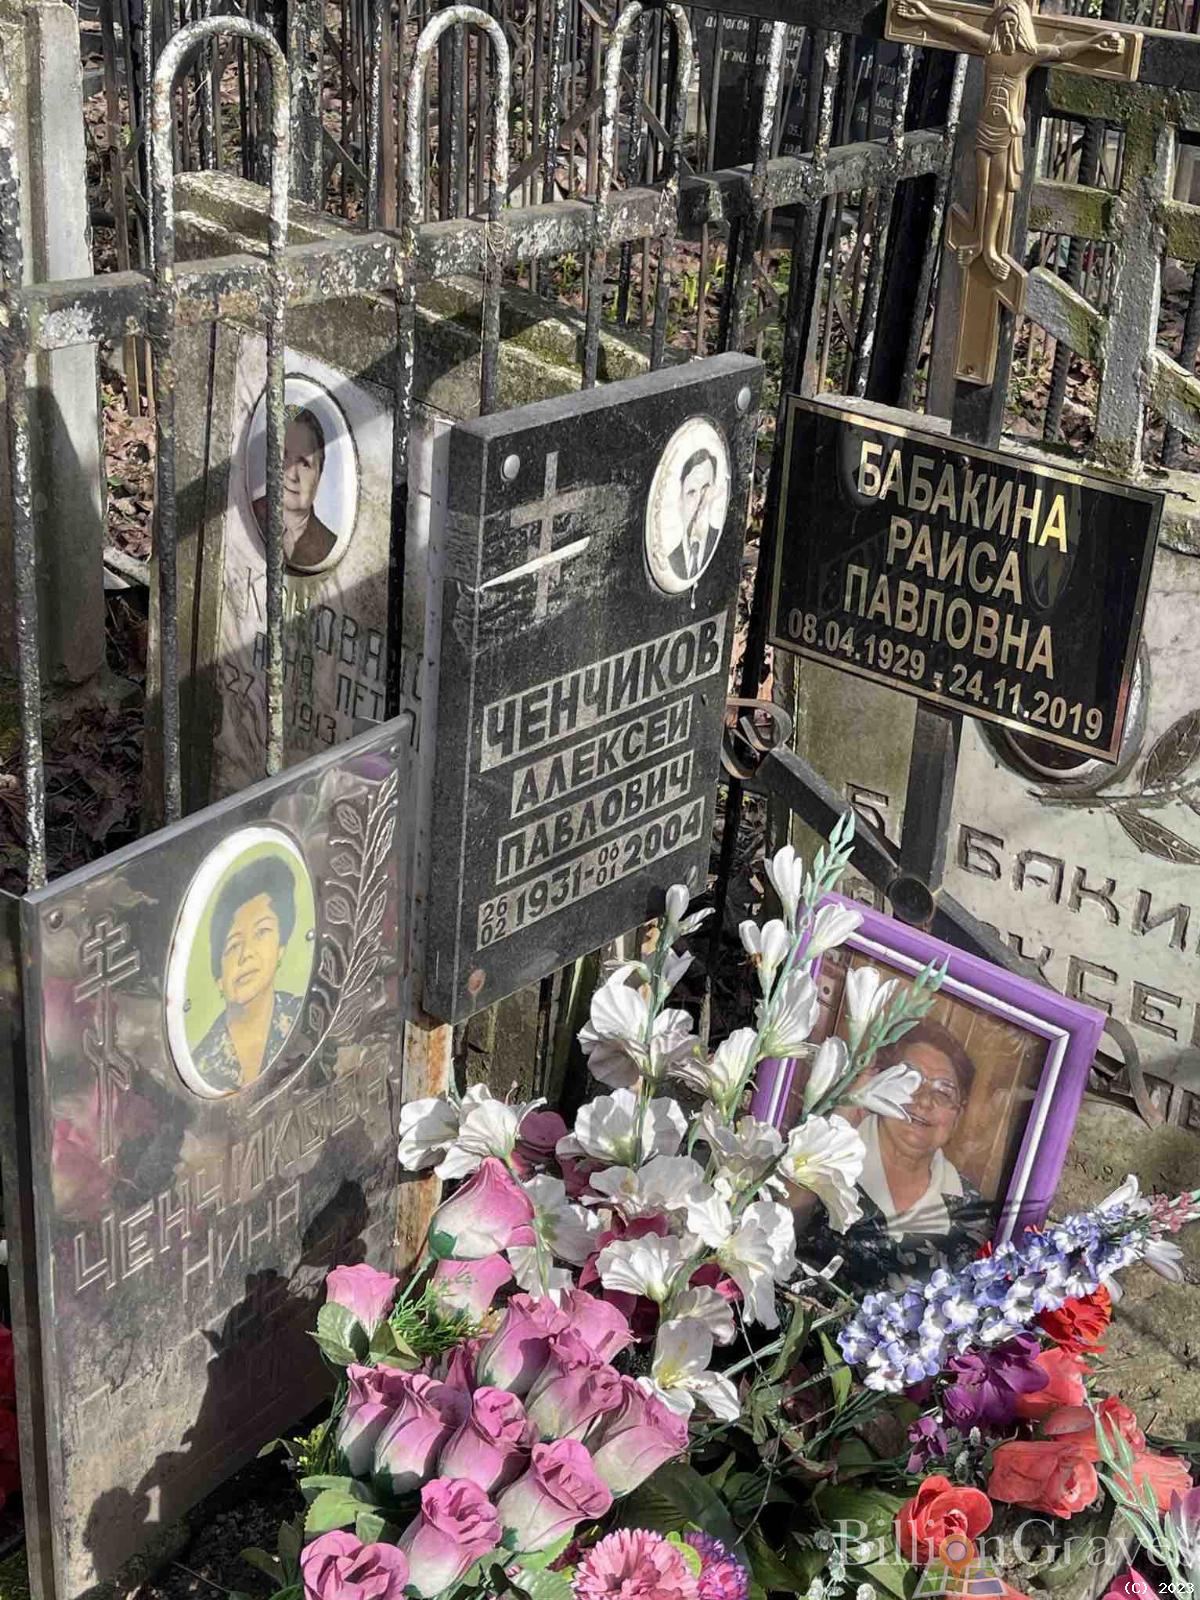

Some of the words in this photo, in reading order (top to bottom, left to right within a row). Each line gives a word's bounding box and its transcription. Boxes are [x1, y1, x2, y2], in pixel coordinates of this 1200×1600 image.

[857, 440, 1069, 553] БАБАКИНА
[886, 515, 1023, 605] РАИСА
[787, 606, 926, 681] 08.04.1929
[949, 662, 1104, 741] 24.11.2019
[843, 563, 1055, 680] ПАВЛОВНА
[484, 618, 722, 759] ЧЕНЧИКОВ
[499, 752, 693, 878] ПАВЛОВИЧ
[622, 801, 702, 873] 2004
[182, 1180, 300, 1304] НИНА
